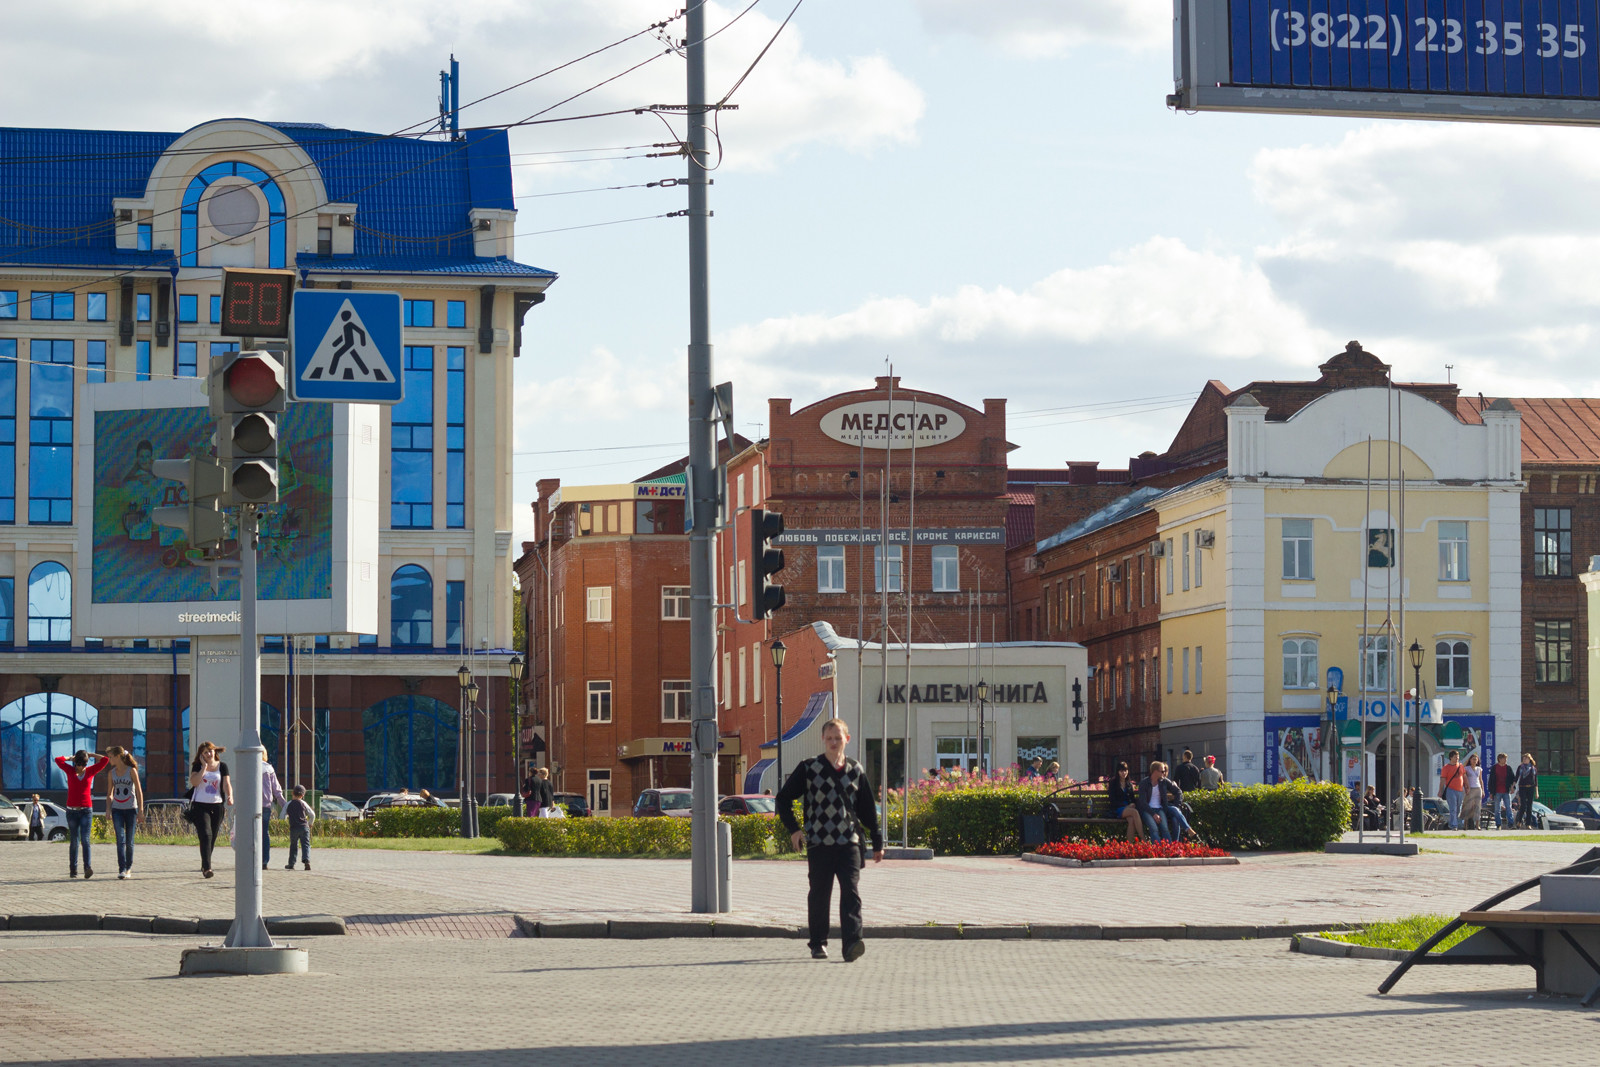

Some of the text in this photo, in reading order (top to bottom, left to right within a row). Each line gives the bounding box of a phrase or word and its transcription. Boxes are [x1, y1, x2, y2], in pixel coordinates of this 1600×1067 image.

[1269, 8, 1587, 59] (3822) 23 35 35
[229, 281, 282, 326] 20
[841, 413, 948, 434] МЕДСТАР
[778, 534, 818, 543] ЛЮБОВЬ
[825, 533, 882, 543] ПОБЕЖДАЕТ
[916, 532, 948, 541] КРОМЕ
[954, 532, 1000, 541] КАРИЕСА!
[877, 682, 1048, 704] АКАДЕМНИГА
